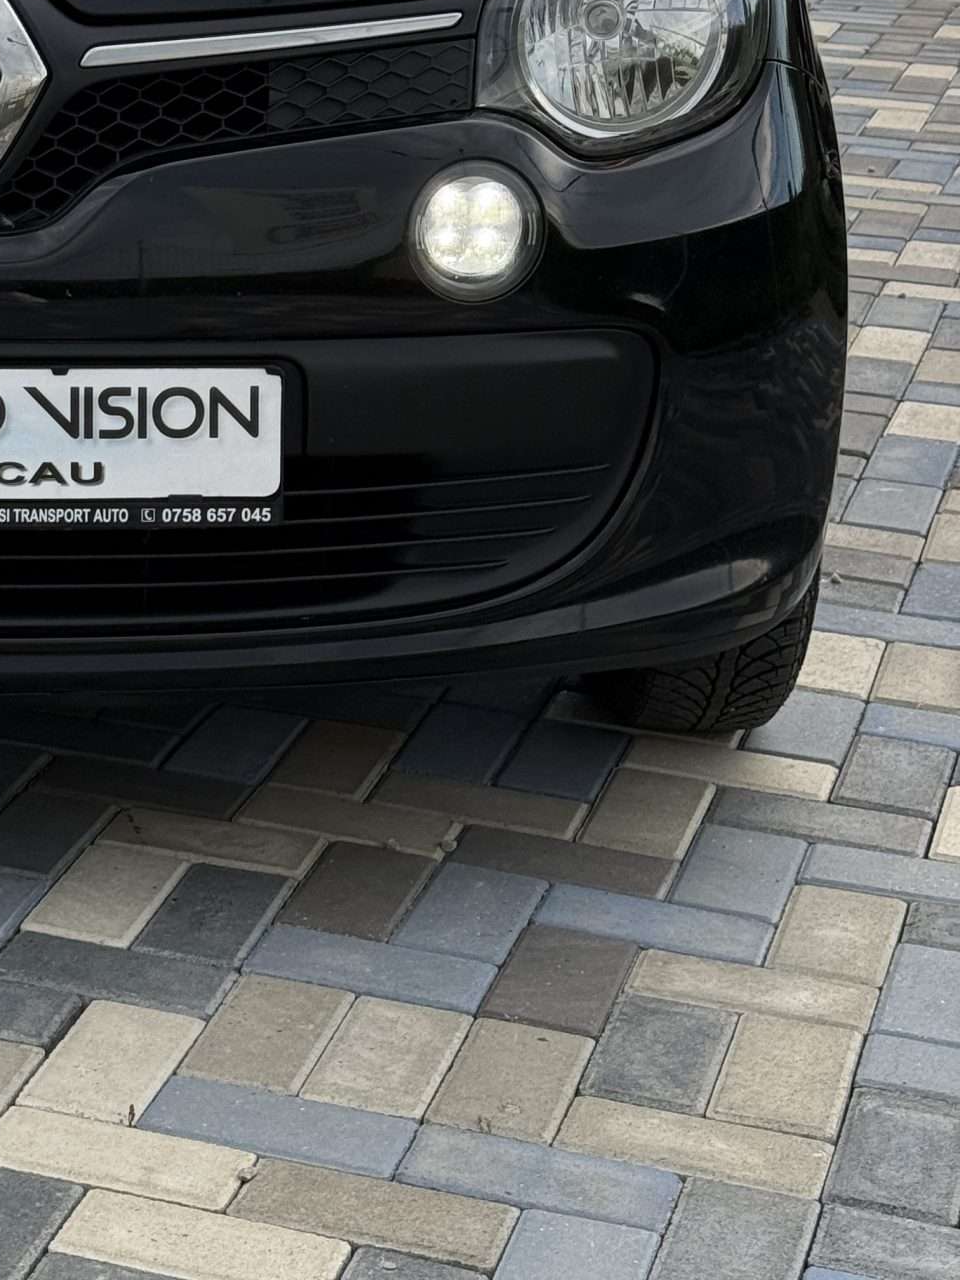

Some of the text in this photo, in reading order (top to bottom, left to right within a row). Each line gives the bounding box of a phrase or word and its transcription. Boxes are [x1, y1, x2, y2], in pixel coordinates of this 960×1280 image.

[23, 385, 259, 439] VISION
[13, 508, 90, 523] TRANSPORT
[93, 508, 128, 523] AUTO
[162, 507, 201, 522] 0758
[206, 507, 236, 522] 657
[241, 507, 271, 522] 045
